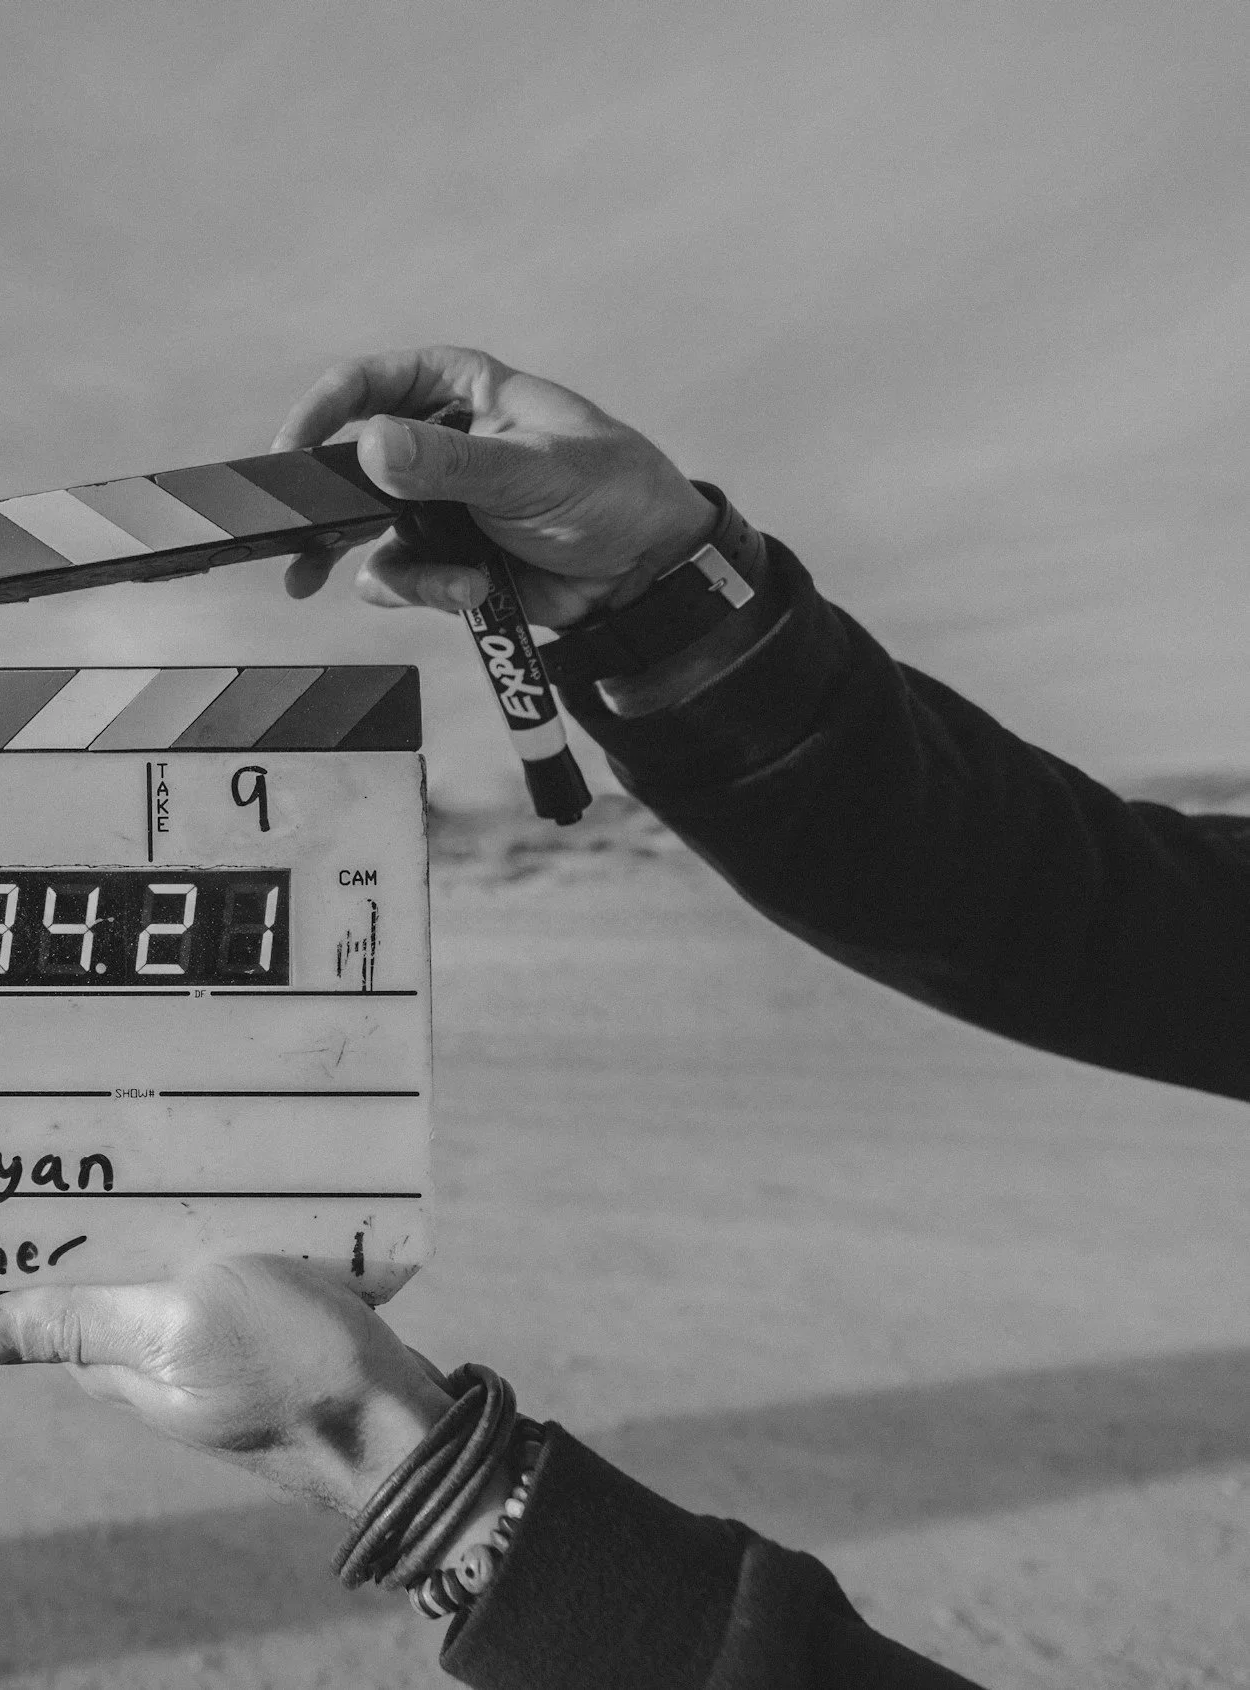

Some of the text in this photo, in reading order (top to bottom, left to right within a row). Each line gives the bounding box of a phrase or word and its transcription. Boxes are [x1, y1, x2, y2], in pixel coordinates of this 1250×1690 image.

[479, 634, 544, 720] EXPO
[515, 624, 542, 681] dry erase
[156, 762, 170, 833] TAKE
[230, 765, 271, 833] 9
[338, 869, 378, 887] CAM
[194, 989, 207, 999] DF
[115, 1088, 155, 1099] SHOW#
